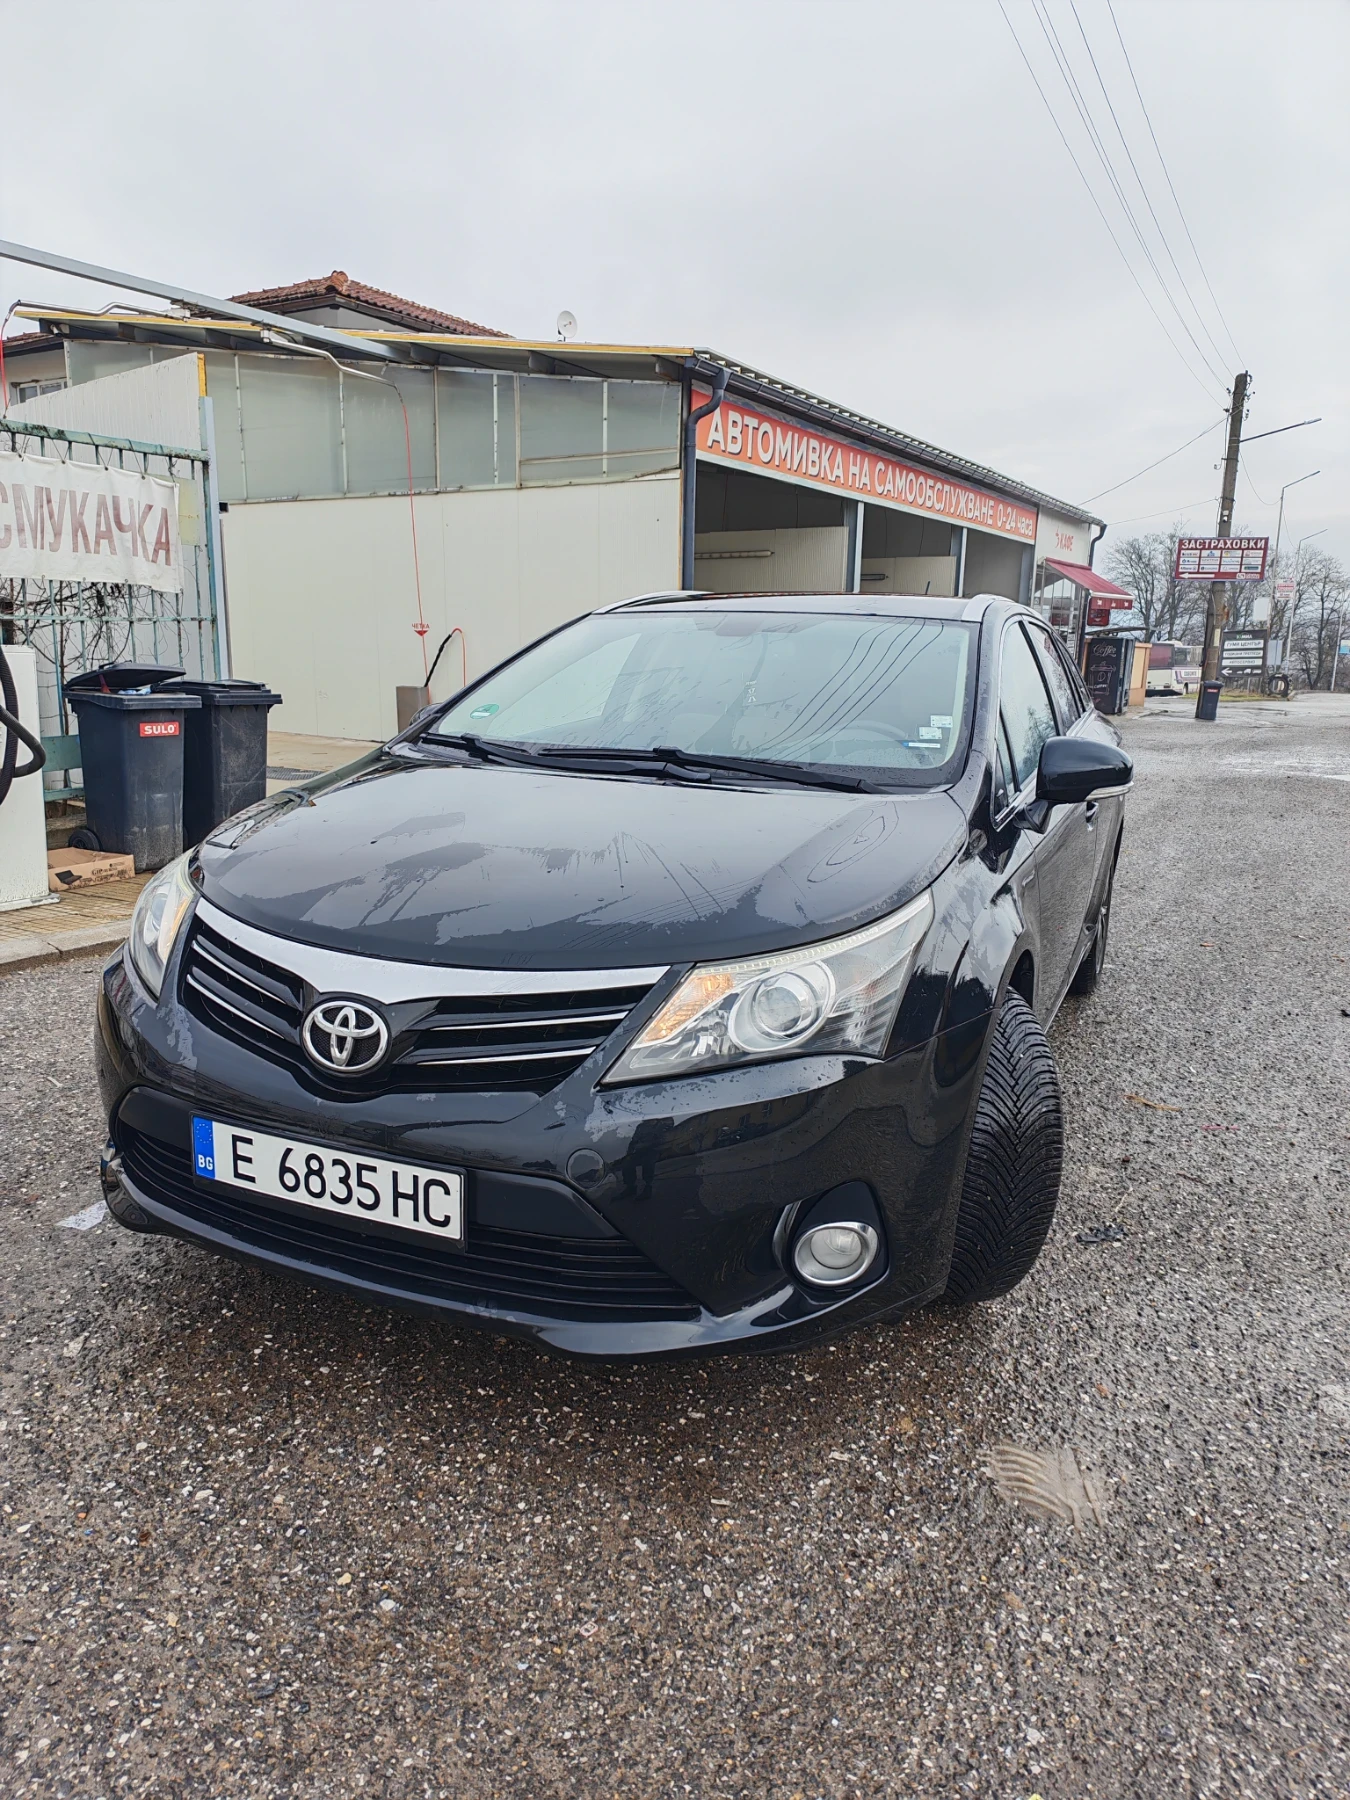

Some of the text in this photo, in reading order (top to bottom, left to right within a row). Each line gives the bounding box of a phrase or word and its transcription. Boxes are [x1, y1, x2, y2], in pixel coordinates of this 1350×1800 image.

[706, 406, 1033, 536] АВТОМИВКА НА САМООБСЛУЖВАНЕ 0-24 часа
[1181, 539, 1265, 549] ЗАСТРАХОВКИ
[144, 724, 175, 735] SULO
[198, 1154, 214, 1171] BG
[231, 1133, 256, 1183] E
[278, 1147, 381, 1212] 6835
